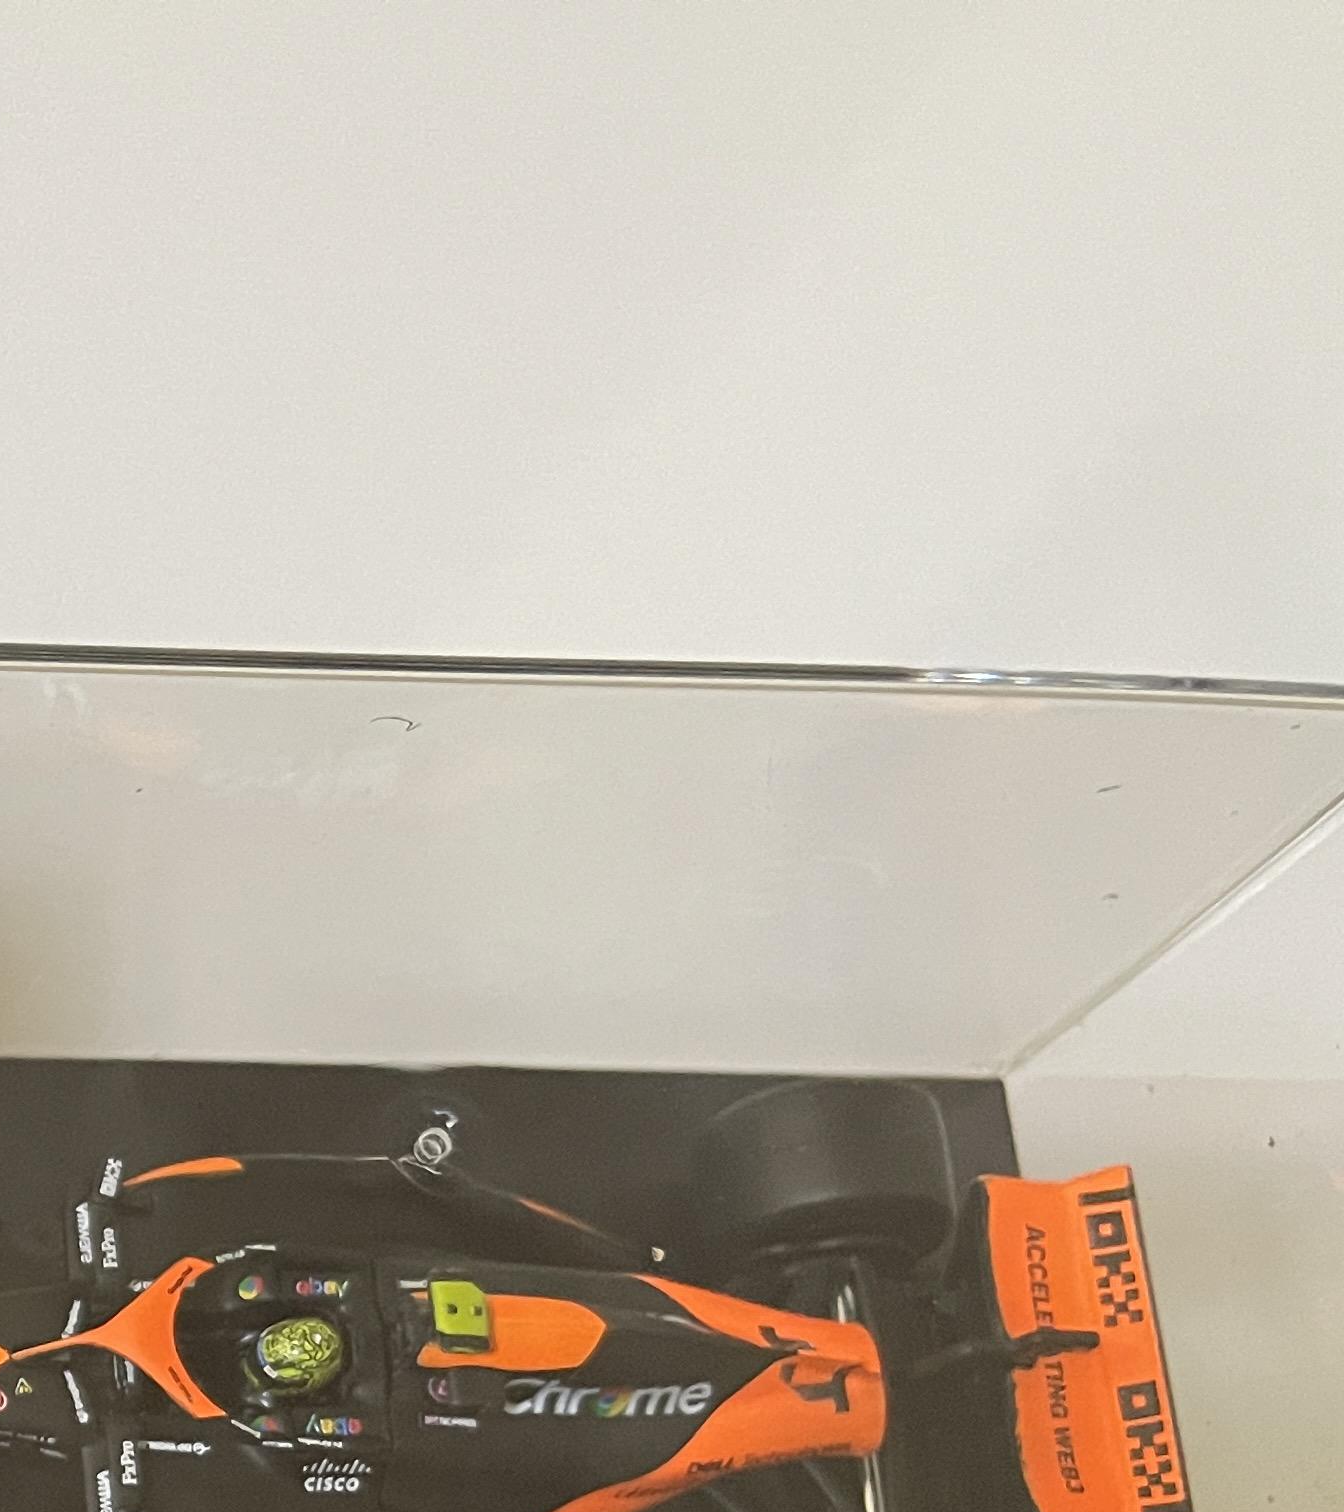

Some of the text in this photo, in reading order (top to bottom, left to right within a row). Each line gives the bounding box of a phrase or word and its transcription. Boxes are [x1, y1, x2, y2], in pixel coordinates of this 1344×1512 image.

[1085, 1210, 1144, 1328] OKX
[503, 1379, 713, 1417] Chrome
[1117, 1380, 1178, 1498] OKX
